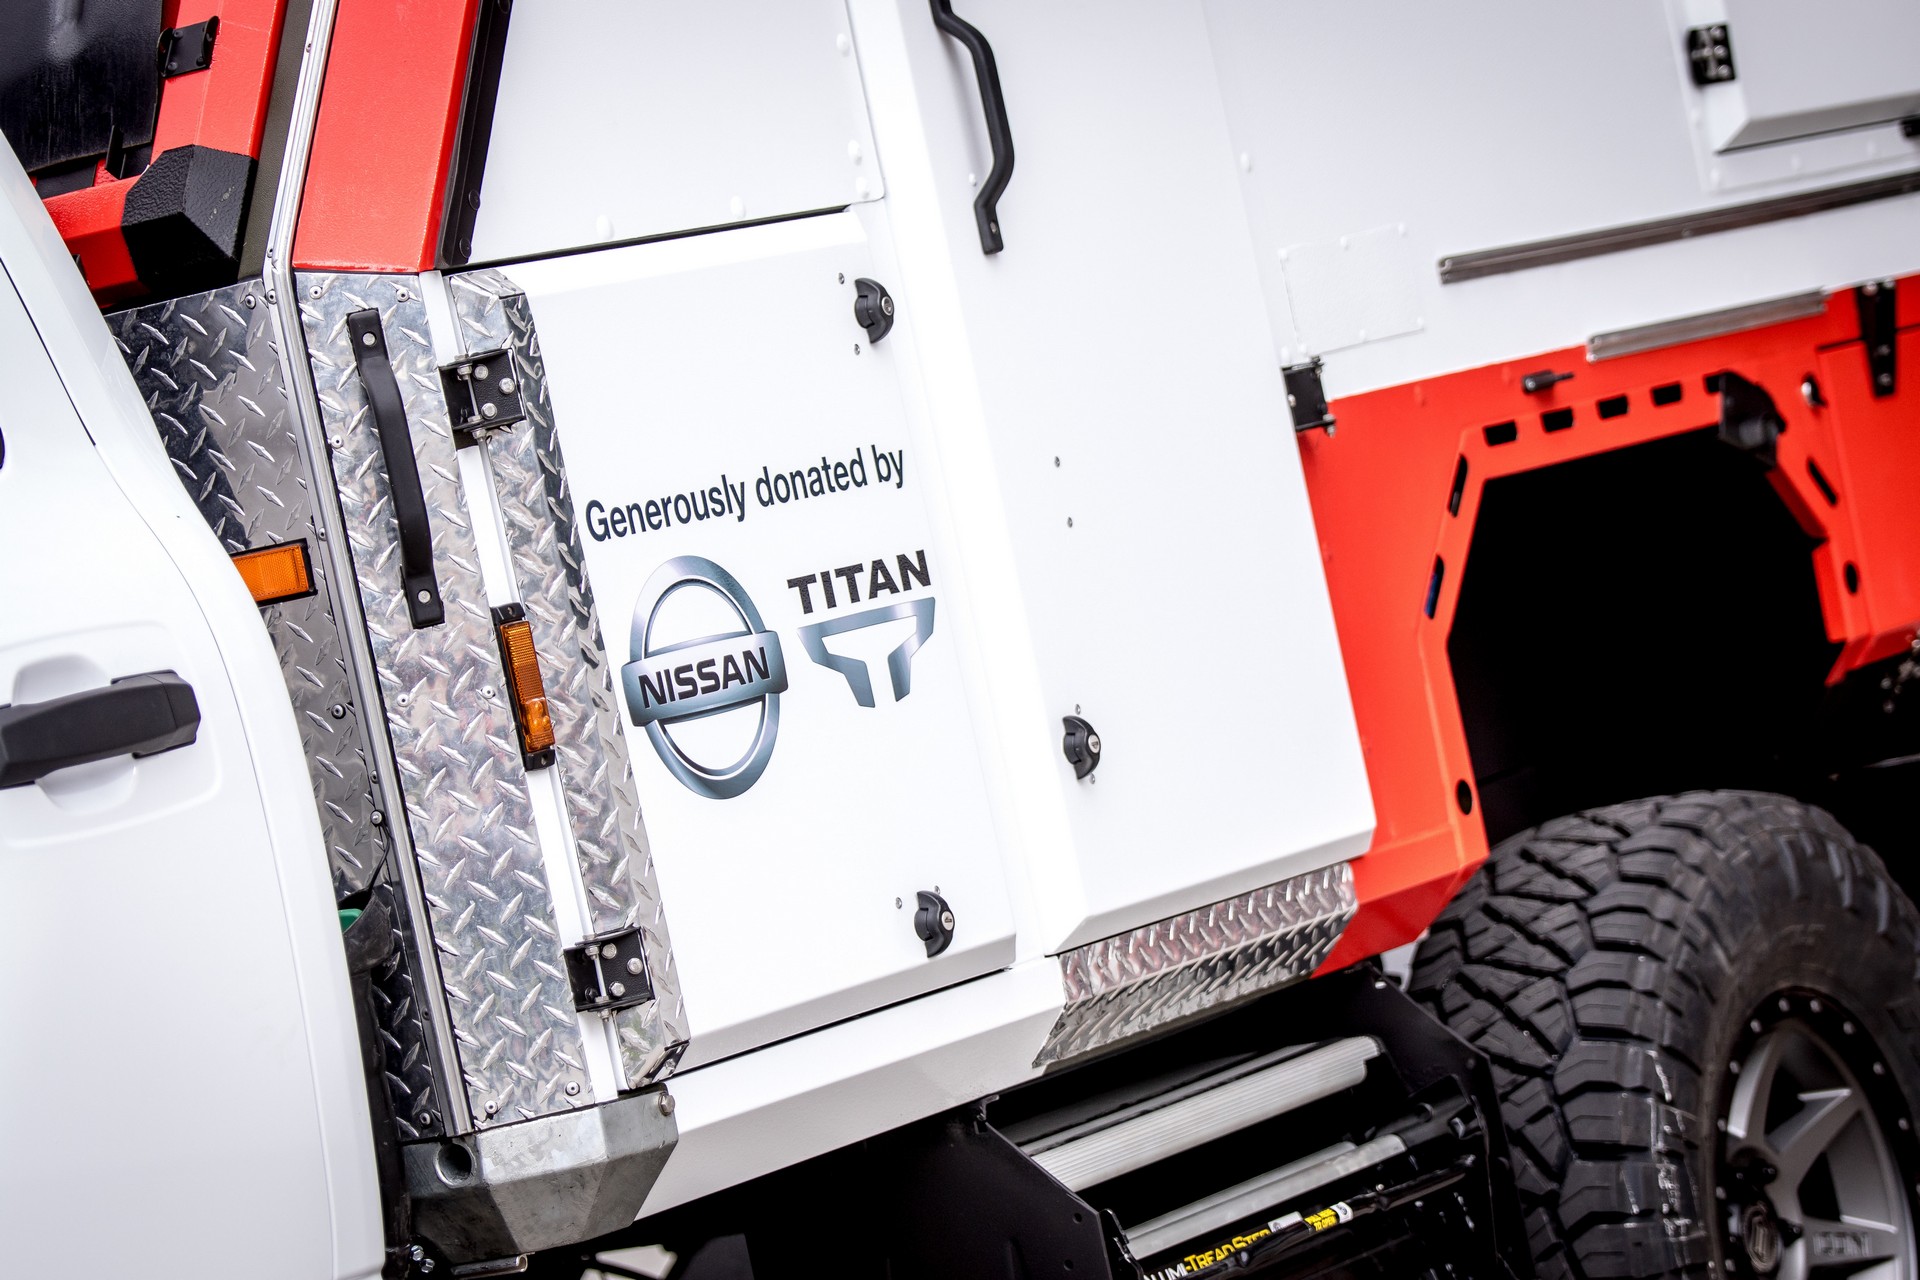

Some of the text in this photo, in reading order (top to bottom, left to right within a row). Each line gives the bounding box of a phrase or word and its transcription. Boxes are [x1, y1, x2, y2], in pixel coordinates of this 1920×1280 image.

[585, 444, 904, 543] Generously donated by
[786, 549, 932, 615] TITAN
[637, 646, 771, 710] NISSAN
